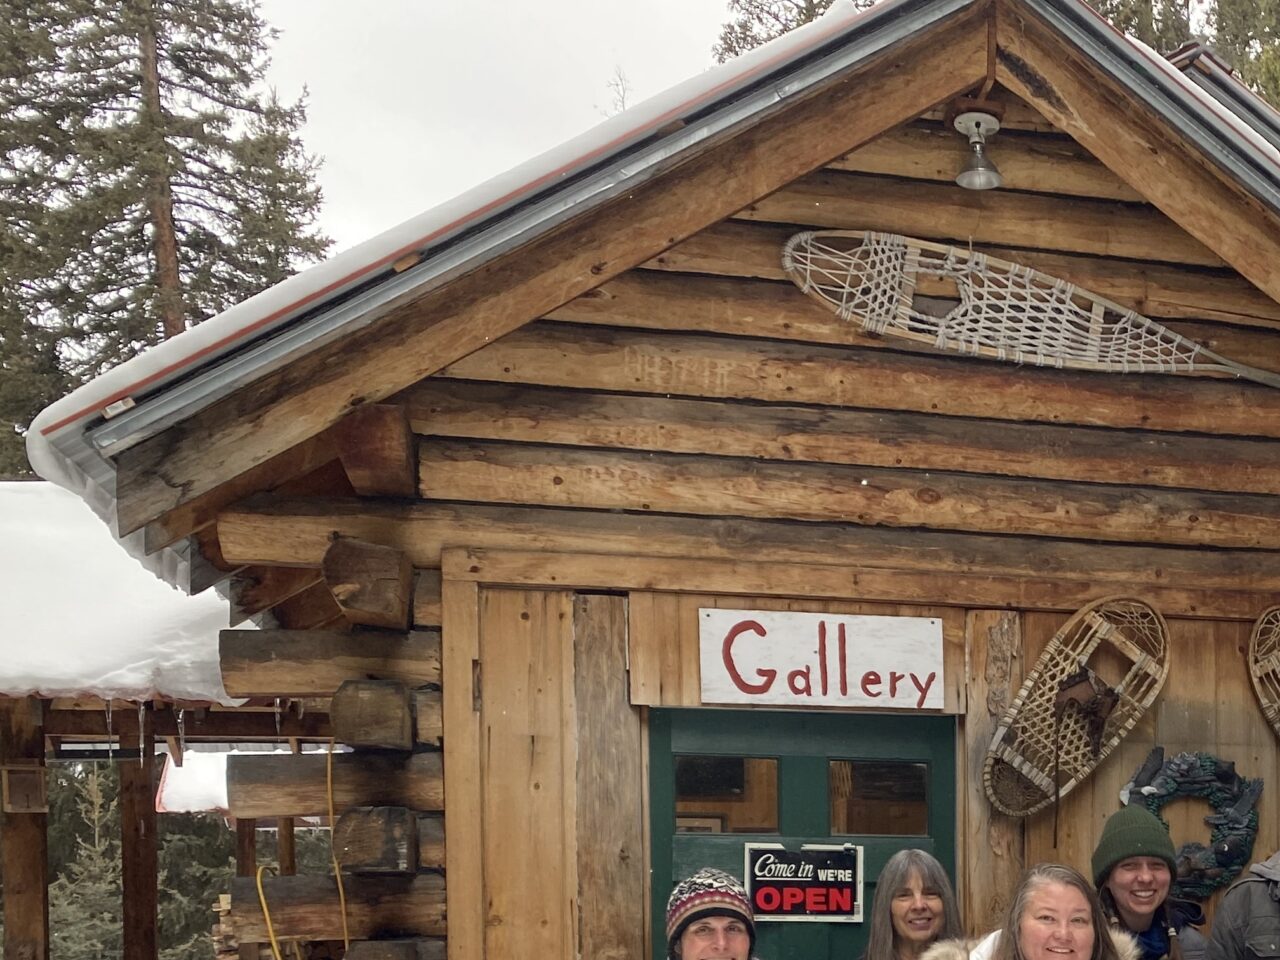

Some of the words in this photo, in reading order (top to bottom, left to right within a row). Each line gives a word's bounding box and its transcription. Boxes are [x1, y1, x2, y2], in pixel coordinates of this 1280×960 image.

[722, 620, 936, 709] Gallery
[754, 853, 795, 877] Come
[797, 861, 814, 877] in
[817, 869, 852, 882] WE'RE
[755, 886, 851, 911] OPEN
